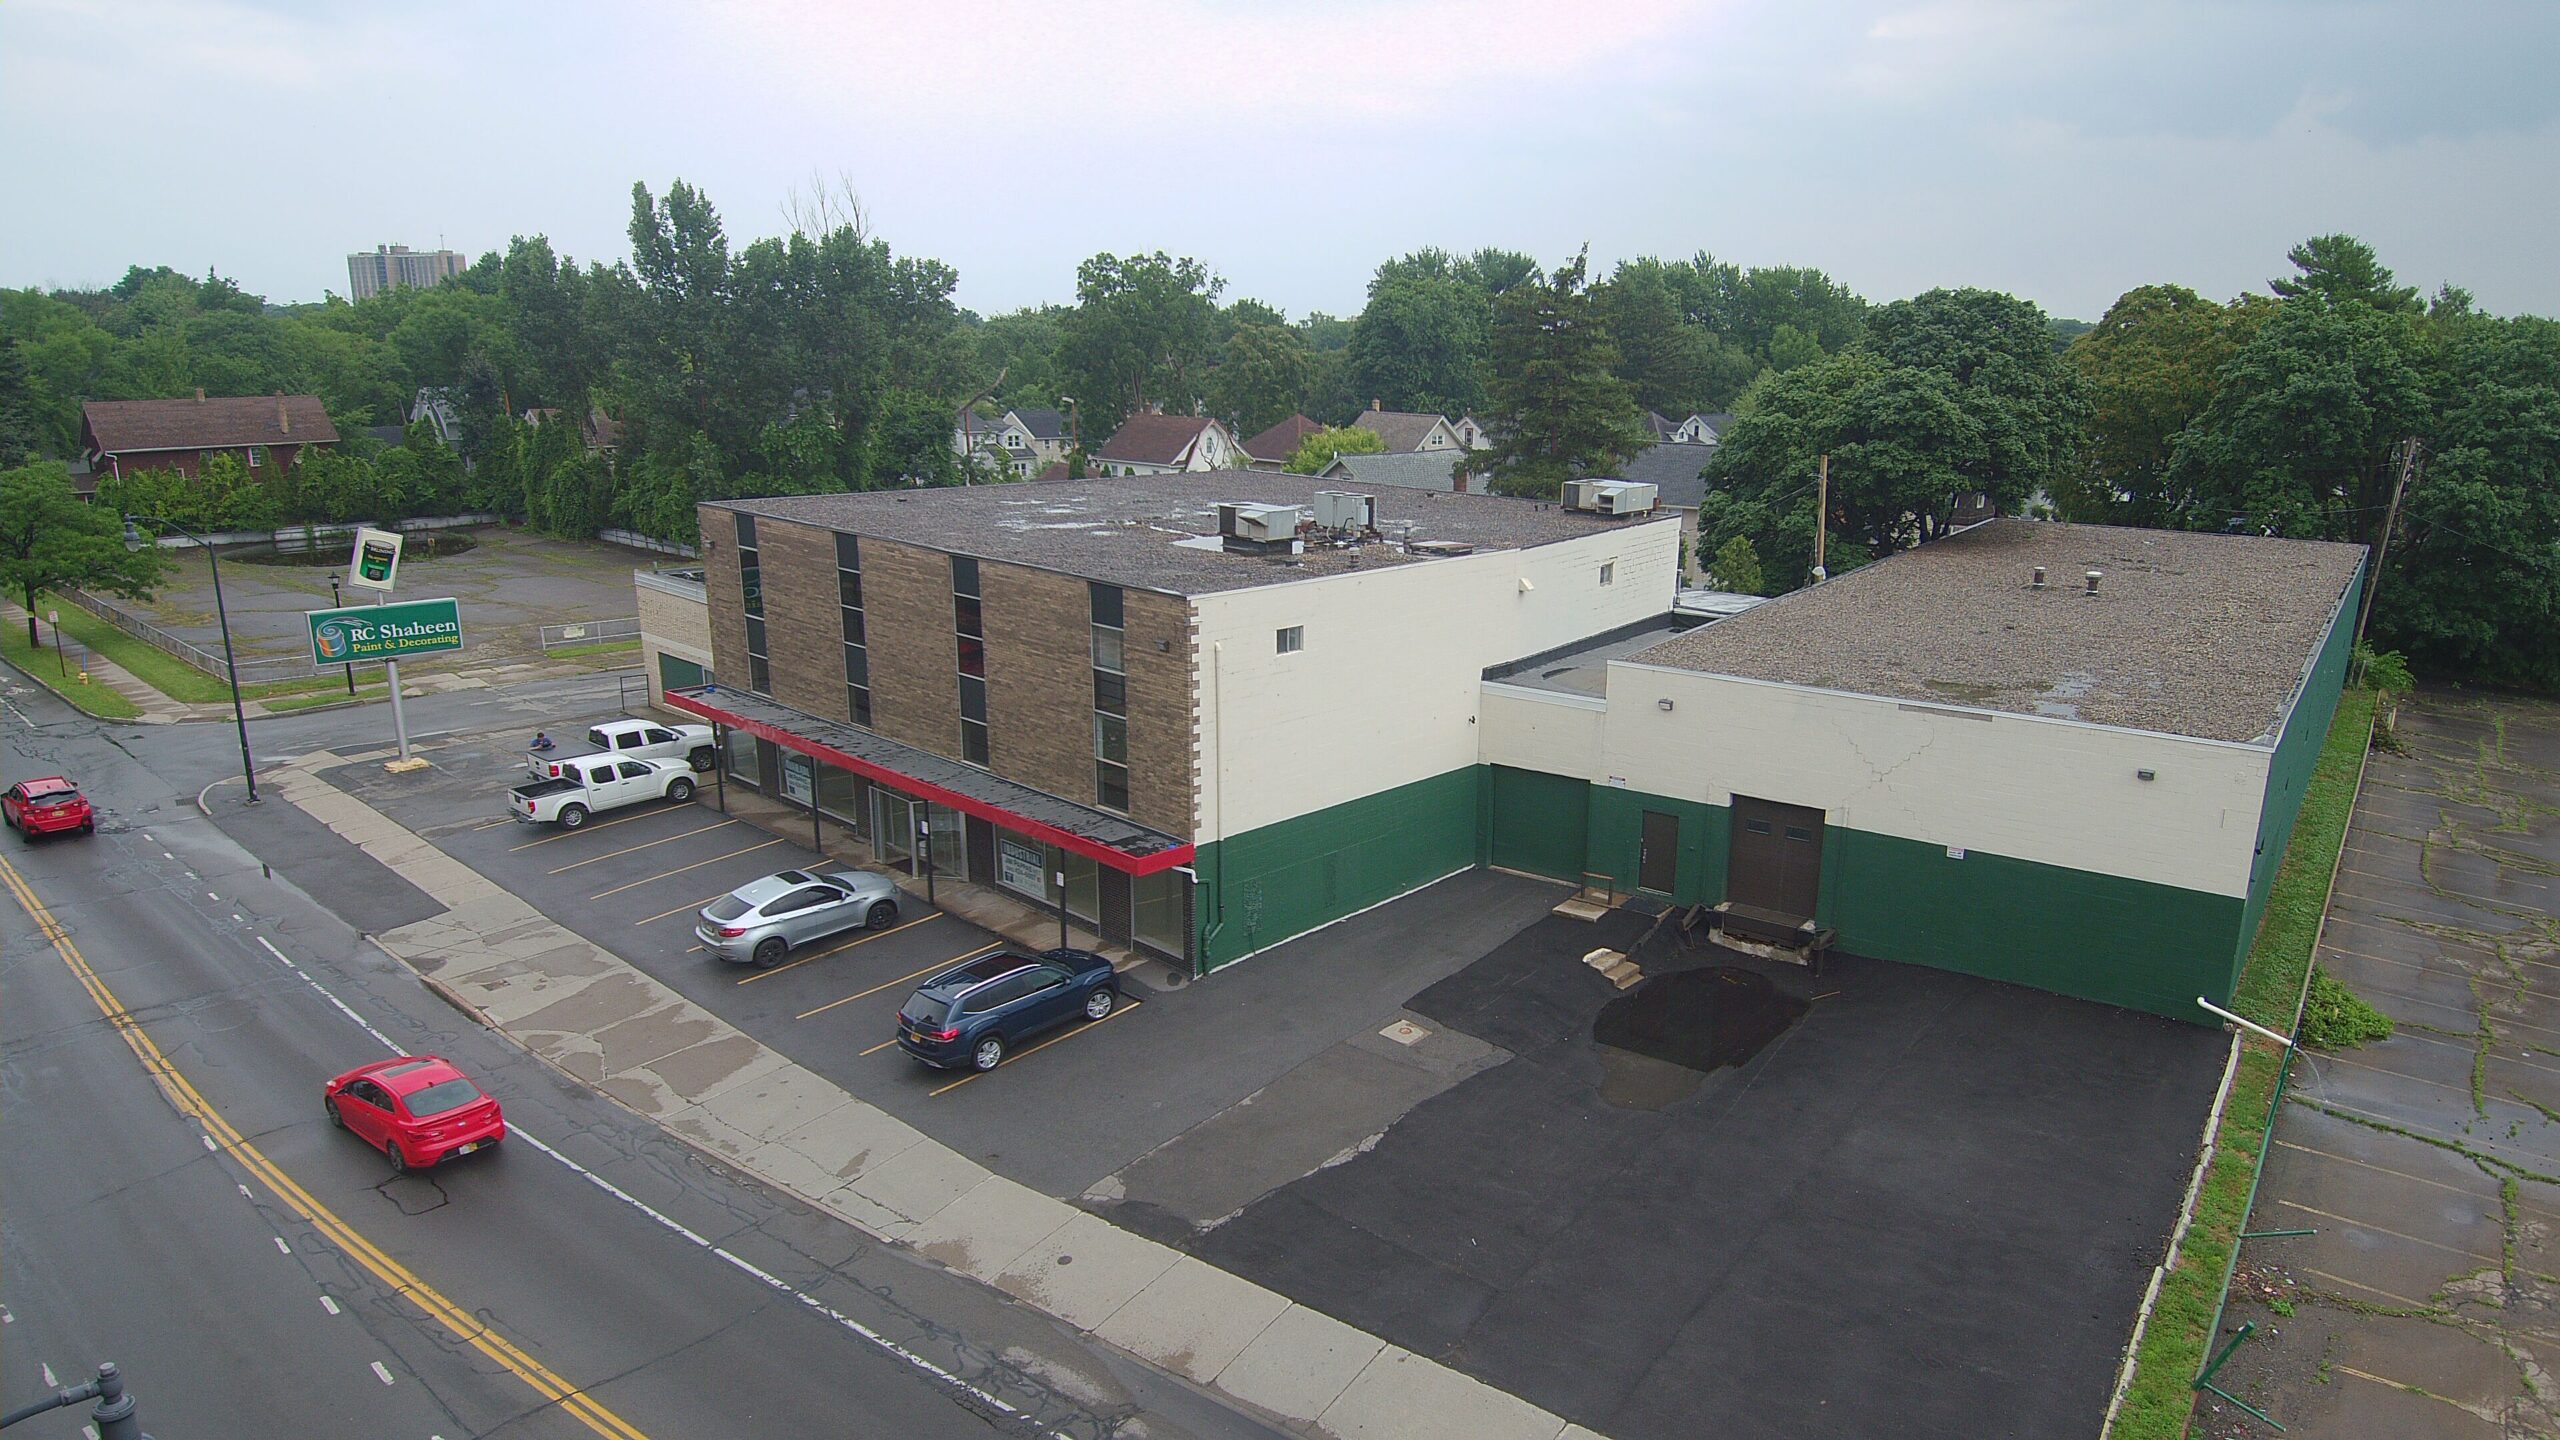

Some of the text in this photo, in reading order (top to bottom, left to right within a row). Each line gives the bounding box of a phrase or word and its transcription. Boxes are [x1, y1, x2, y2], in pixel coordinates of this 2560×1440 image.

[351, 621, 457, 642] RC Shaheen
[353, 634, 459, 653] Paint & Decorating
